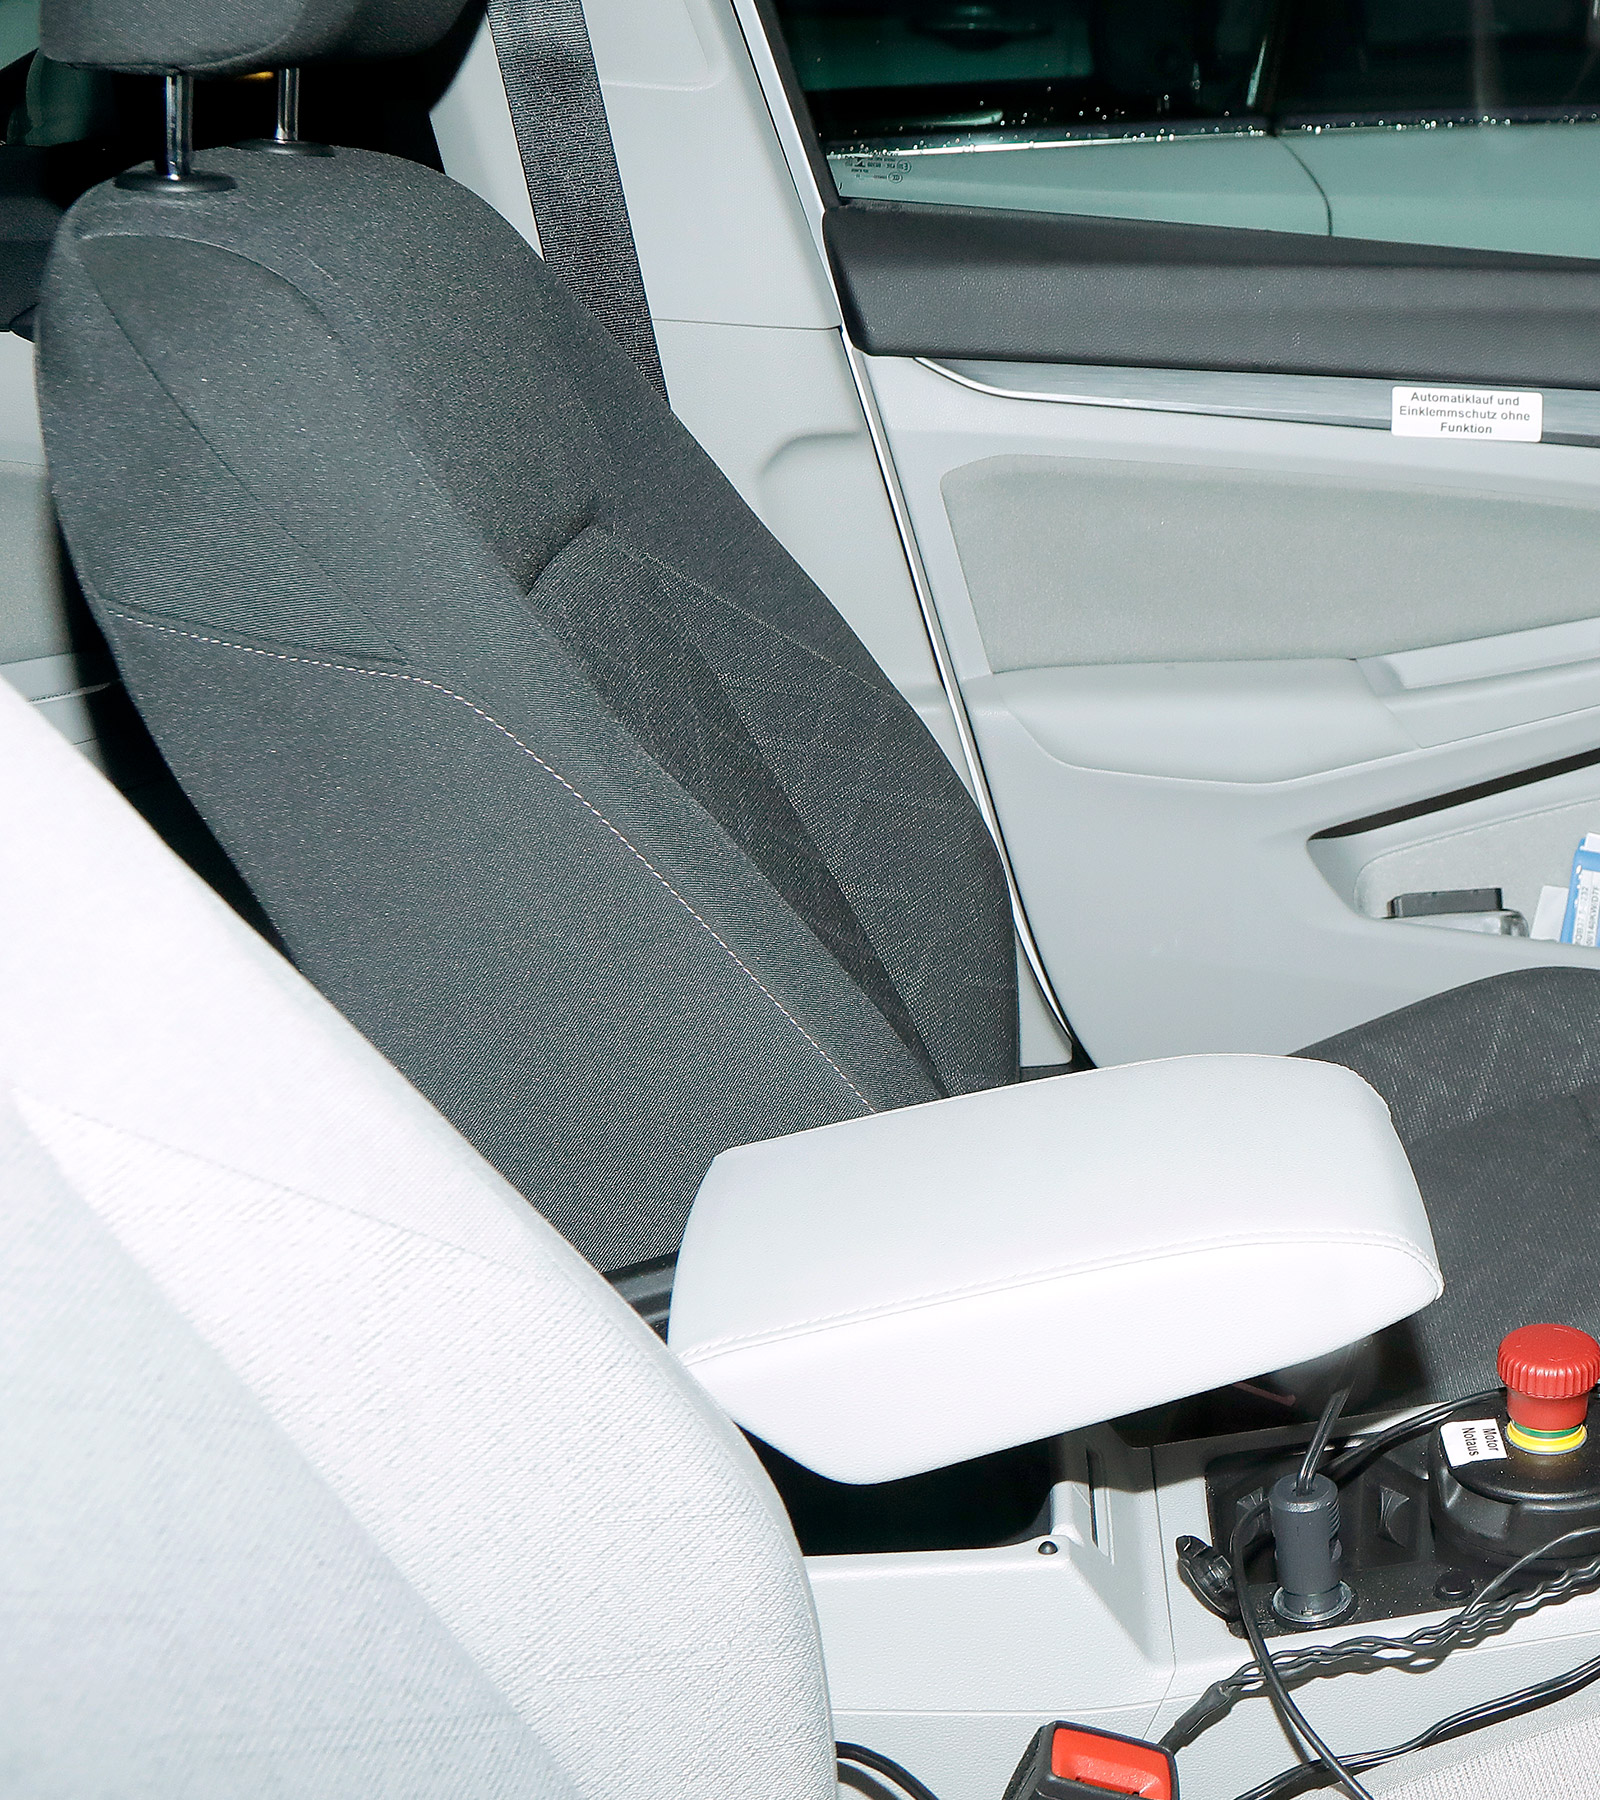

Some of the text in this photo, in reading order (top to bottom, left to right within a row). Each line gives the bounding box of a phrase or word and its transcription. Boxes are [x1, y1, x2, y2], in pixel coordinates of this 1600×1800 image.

[1410, 391, 1520, 406] Automatiklauf und
[1399, 405, 1531, 421] Einklemmschutz ohne
[1440, 421, 1493, 434] Funktion
[1461, 1427, 1480, 1457] Notaus
[1482, 1428, 1500, 1452] Motor
